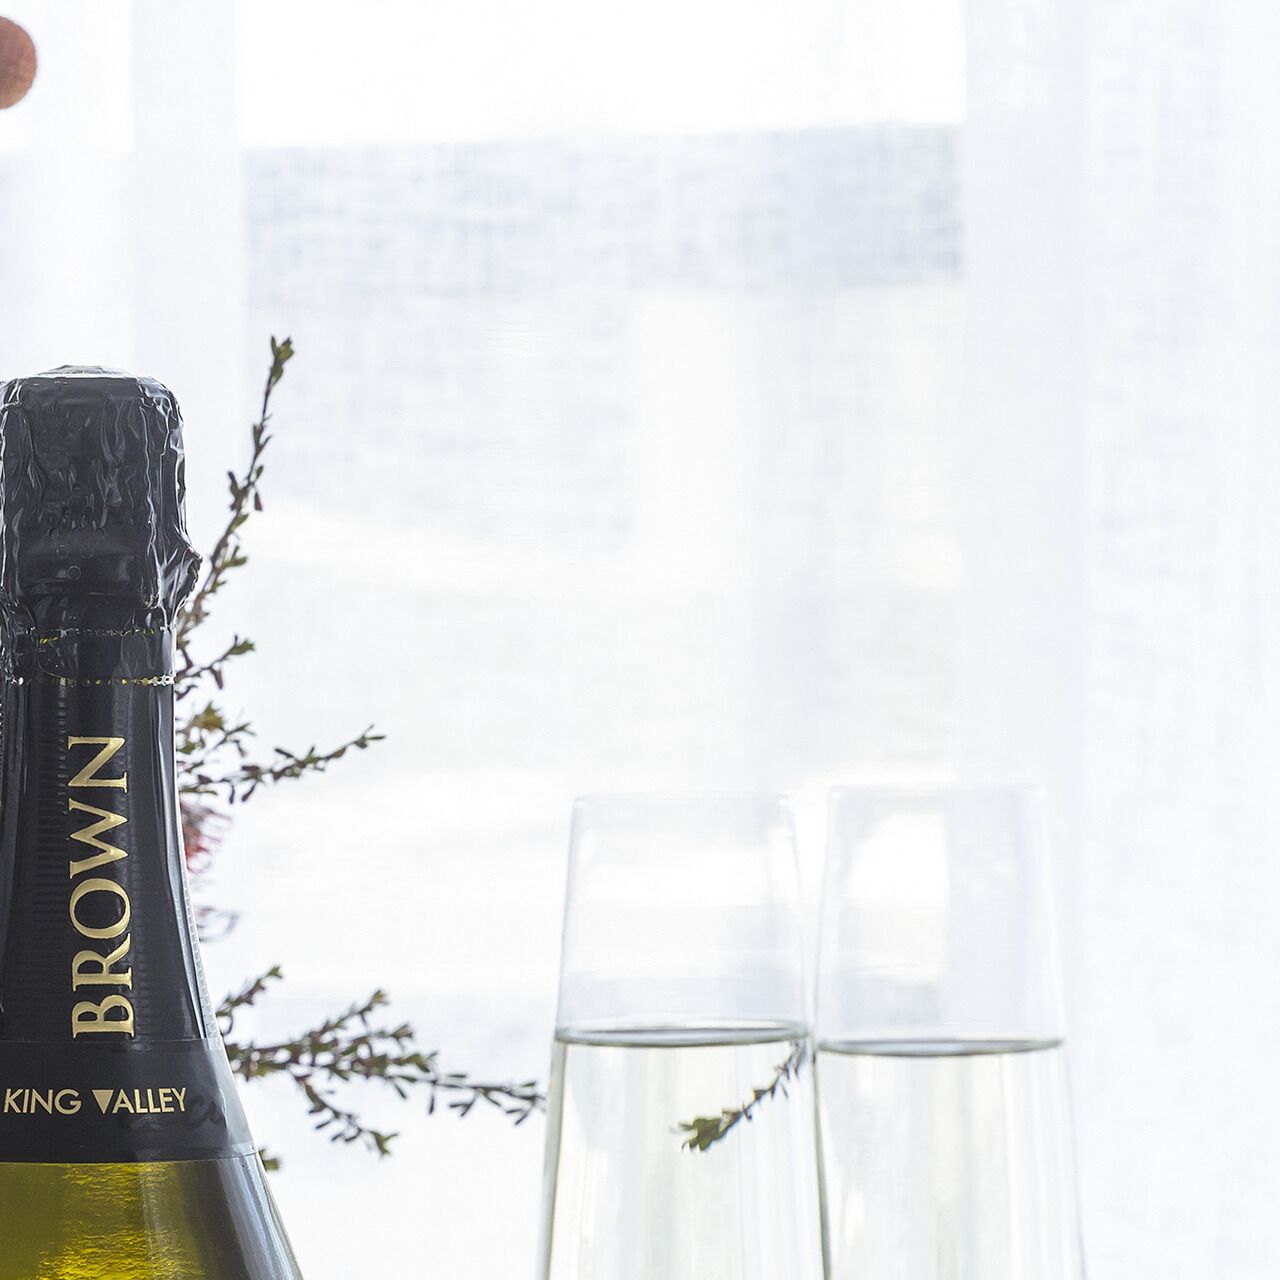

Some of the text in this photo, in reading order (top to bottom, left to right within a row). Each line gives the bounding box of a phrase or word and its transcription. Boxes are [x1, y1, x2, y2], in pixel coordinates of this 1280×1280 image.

[68, 736, 135, 1039] BROWN
[3, 1087, 186, 1115] KING VALLEY
